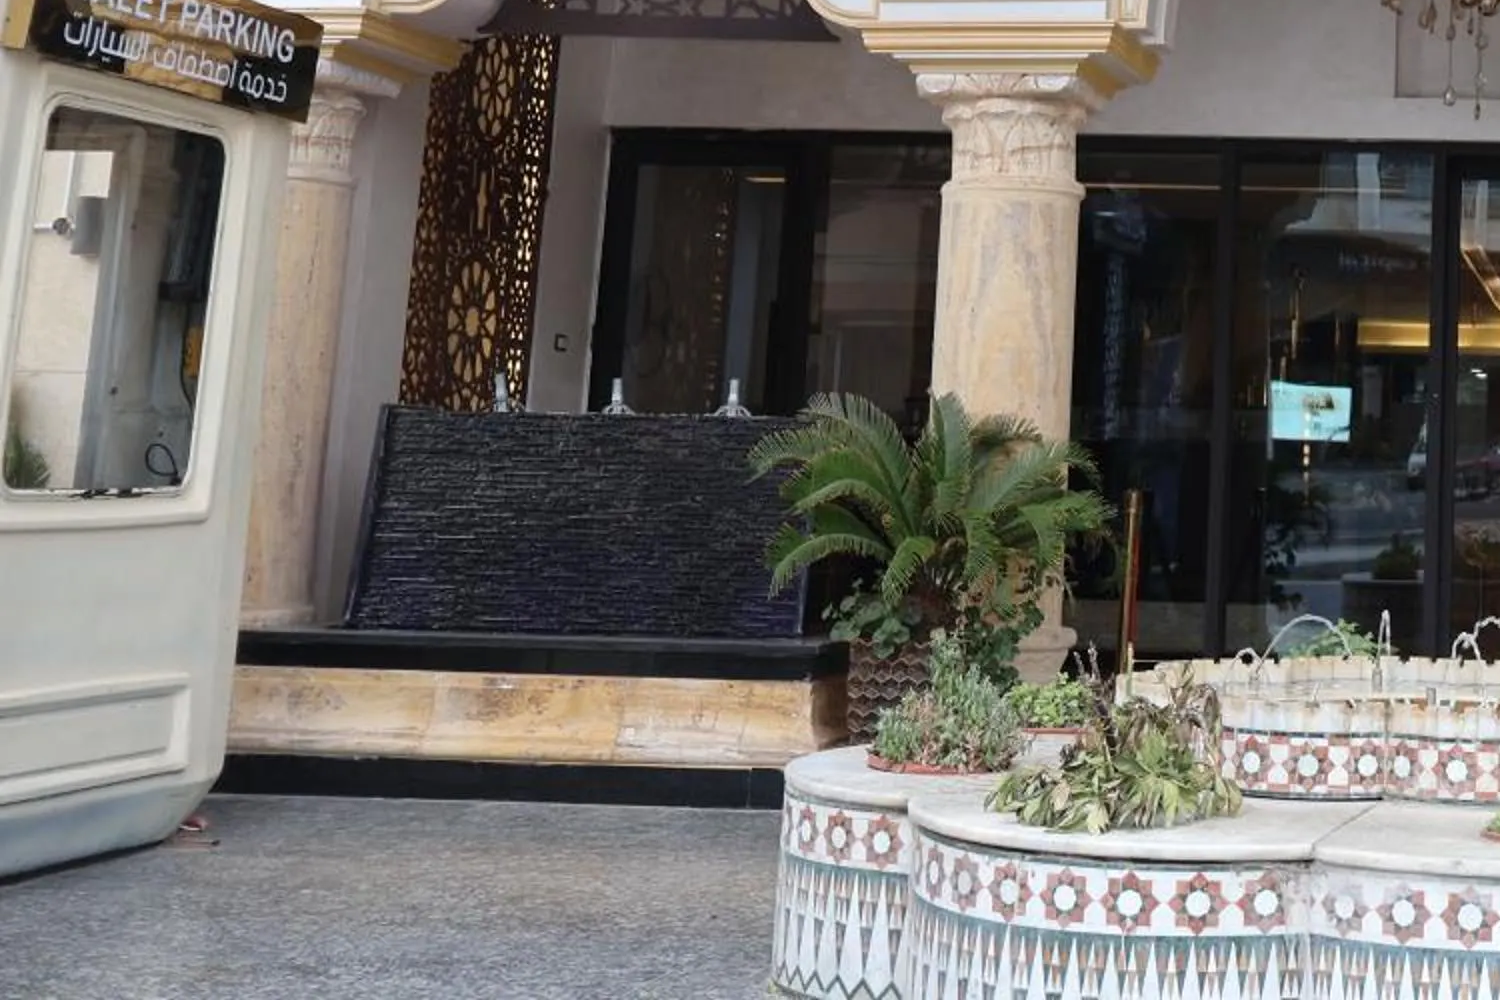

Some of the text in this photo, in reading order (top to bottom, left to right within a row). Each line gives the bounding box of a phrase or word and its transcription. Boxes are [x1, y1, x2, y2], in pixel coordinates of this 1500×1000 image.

[64, 11, 289, 103] خدمة اصطفاف السيارات
